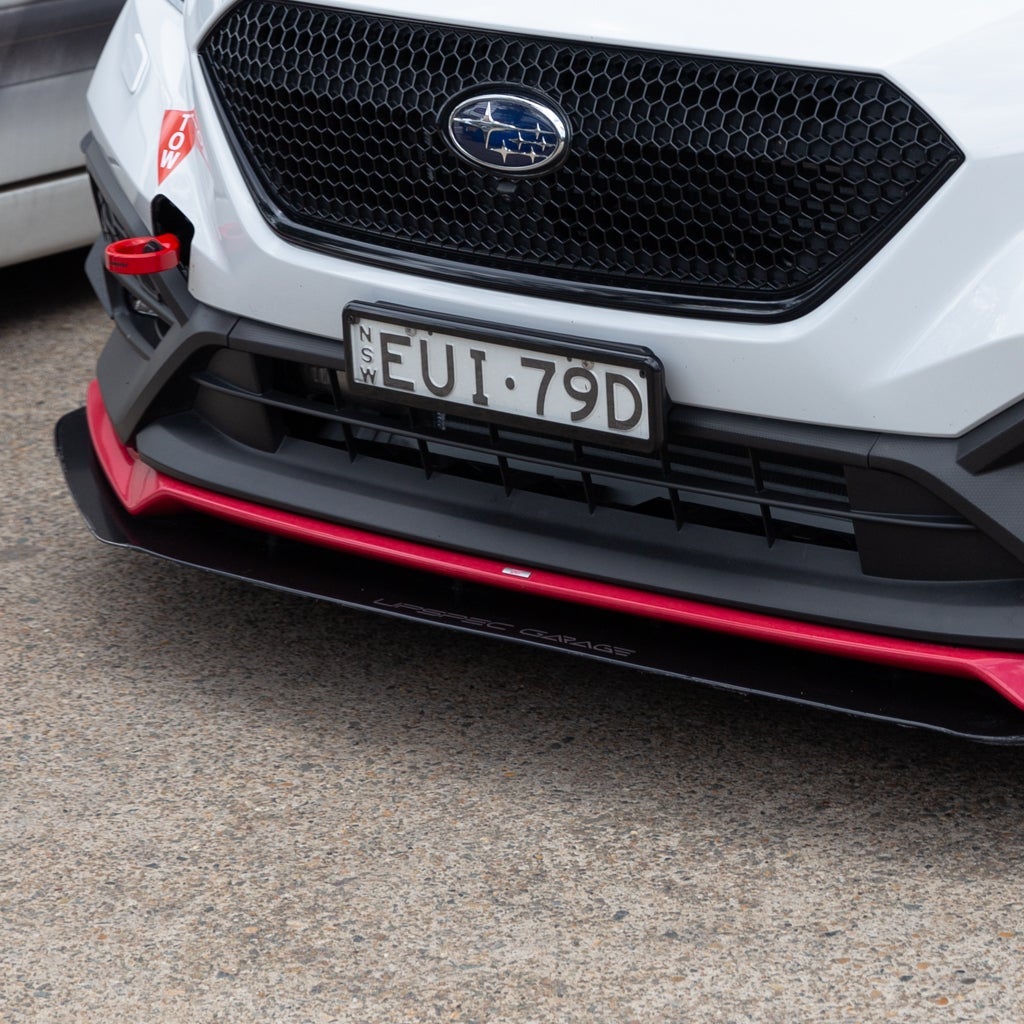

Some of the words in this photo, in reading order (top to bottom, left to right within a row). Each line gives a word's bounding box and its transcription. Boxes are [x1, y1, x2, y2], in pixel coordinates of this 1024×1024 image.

[159, 112, 193, 169] TOW
[359, 326, 376, 384] NSW
[519, 627, 637, 657] GARAGE
